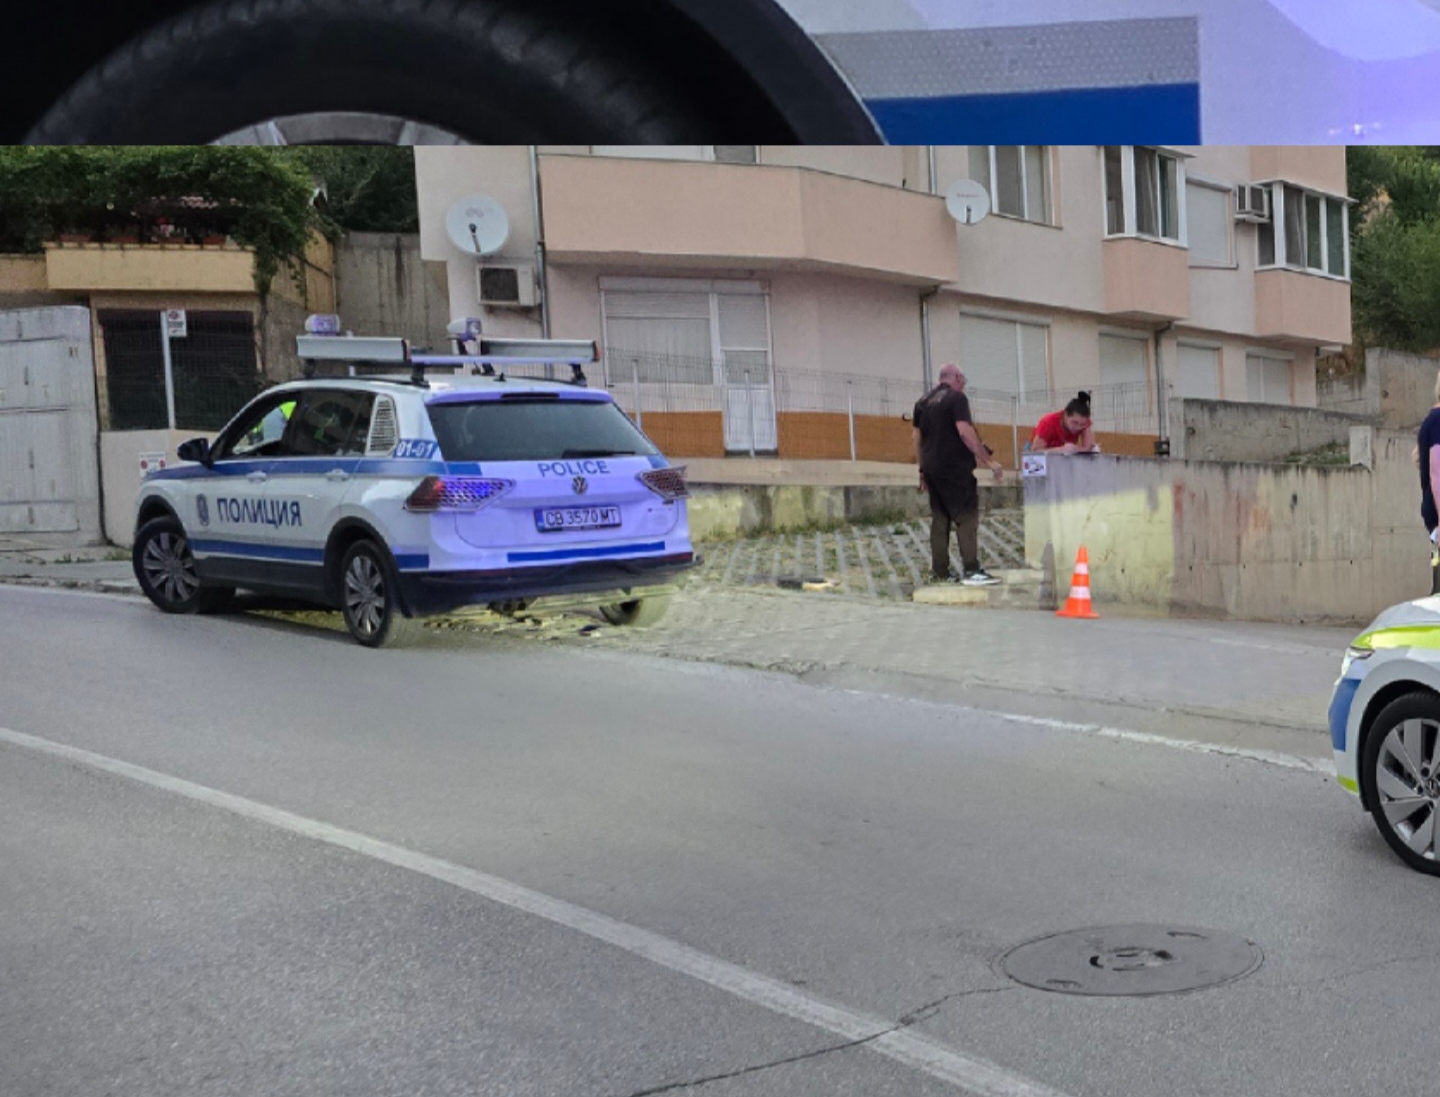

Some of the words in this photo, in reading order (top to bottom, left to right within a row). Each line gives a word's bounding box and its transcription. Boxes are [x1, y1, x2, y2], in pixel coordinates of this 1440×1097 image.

[396, 440, 434, 458] 01-01
[537, 460, 611, 477] POLICE
[217, 497, 302, 529] ПОЛИЦИЯ
